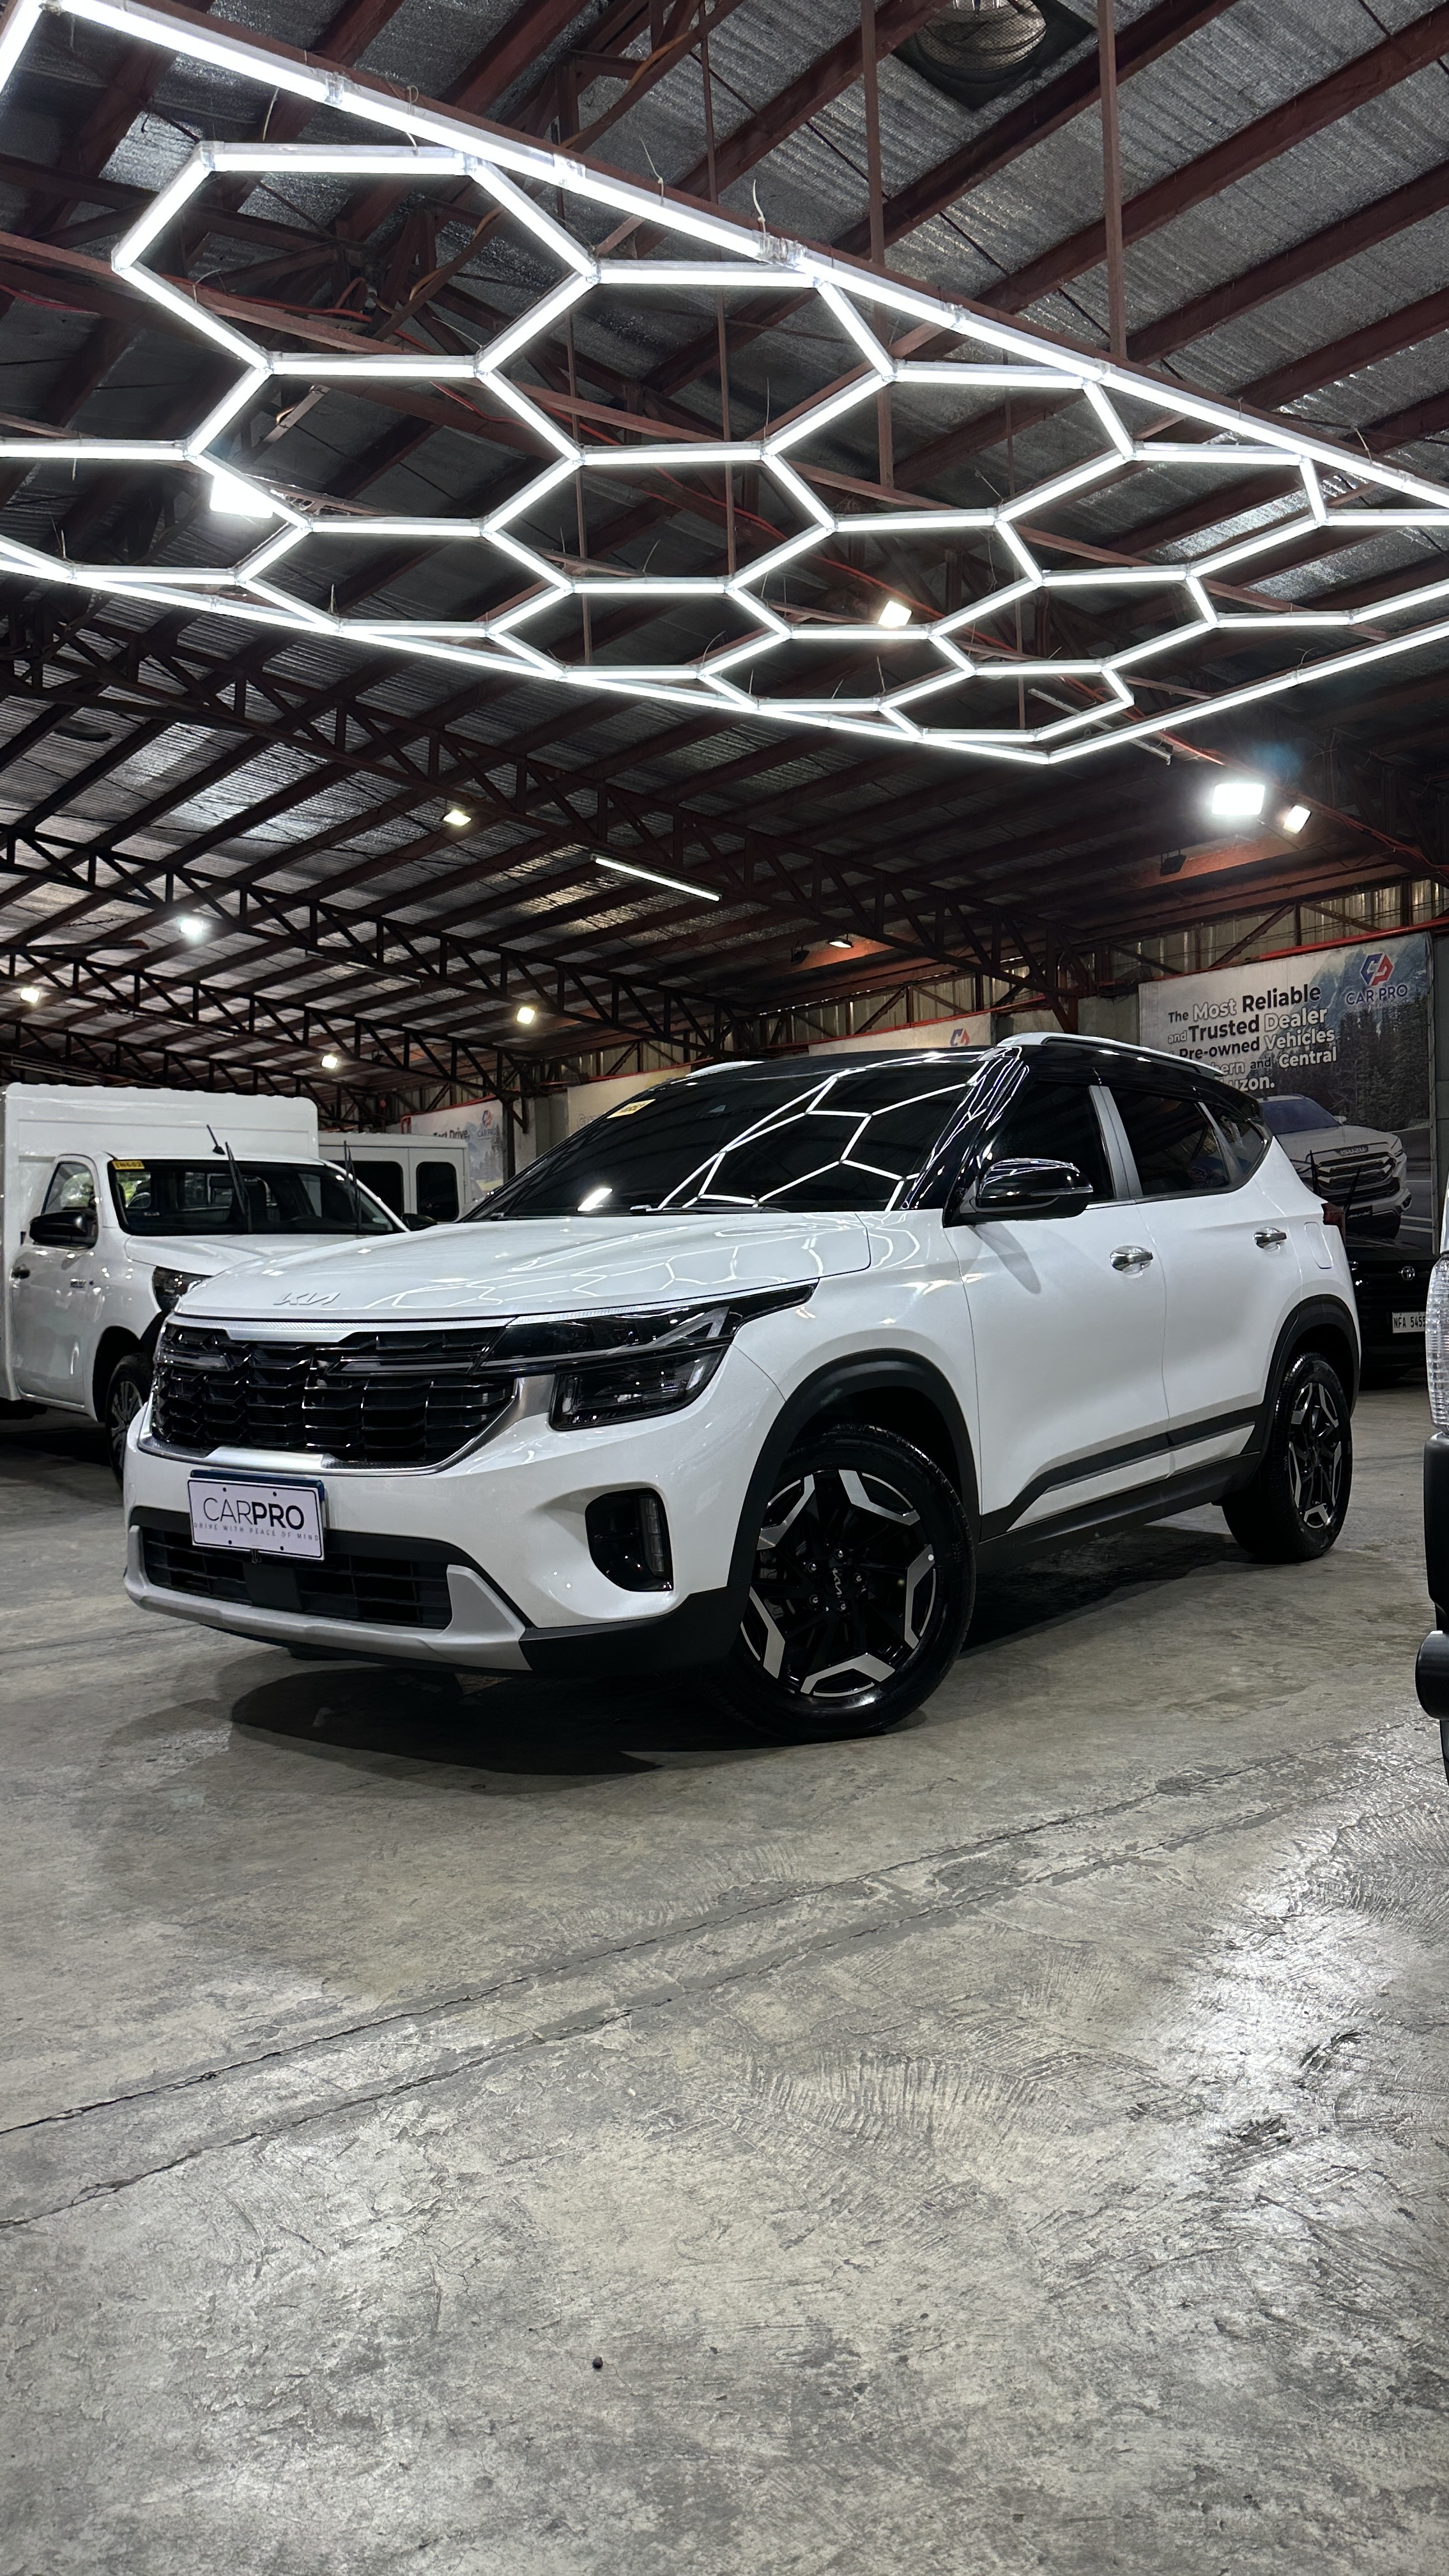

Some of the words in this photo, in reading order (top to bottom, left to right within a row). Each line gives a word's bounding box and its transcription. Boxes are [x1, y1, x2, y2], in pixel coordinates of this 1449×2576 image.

[1168, 1011, 1189, 1023] The
[1193, 999, 1237, 1022] Most
[1242, 984, 1322, 1013] Reliable
[1346, 990, 1374, 1005] CAR
[1379, 985, 1407, 1000] PRO
[1168, 1030, 1187, 1044] and
[1188, 1014, 1259, 1042] Trusted
[1264, 1007, 1328, 1032] Dealer
[1179, 1036, 1260, 1060] Pre-owned
[1264, 1028, 1335, 1050] Vehicles
[1250, 1057, 1271, 1070] and
[1278, 1046, 1337, 1068] Central
[1340, 1147, 1367, 1156] ISUZU
[273, 1291, 341, 1305] KIA
[1393, 1317, 1406, 1328] NFA
[203, 1498, 304, 1530] CARPRO
[194, 1522, 218, 1530] DRIVE
[250, 1528, 276, 1537] PEACE
[297, 1533, 319, 1541] MIND
